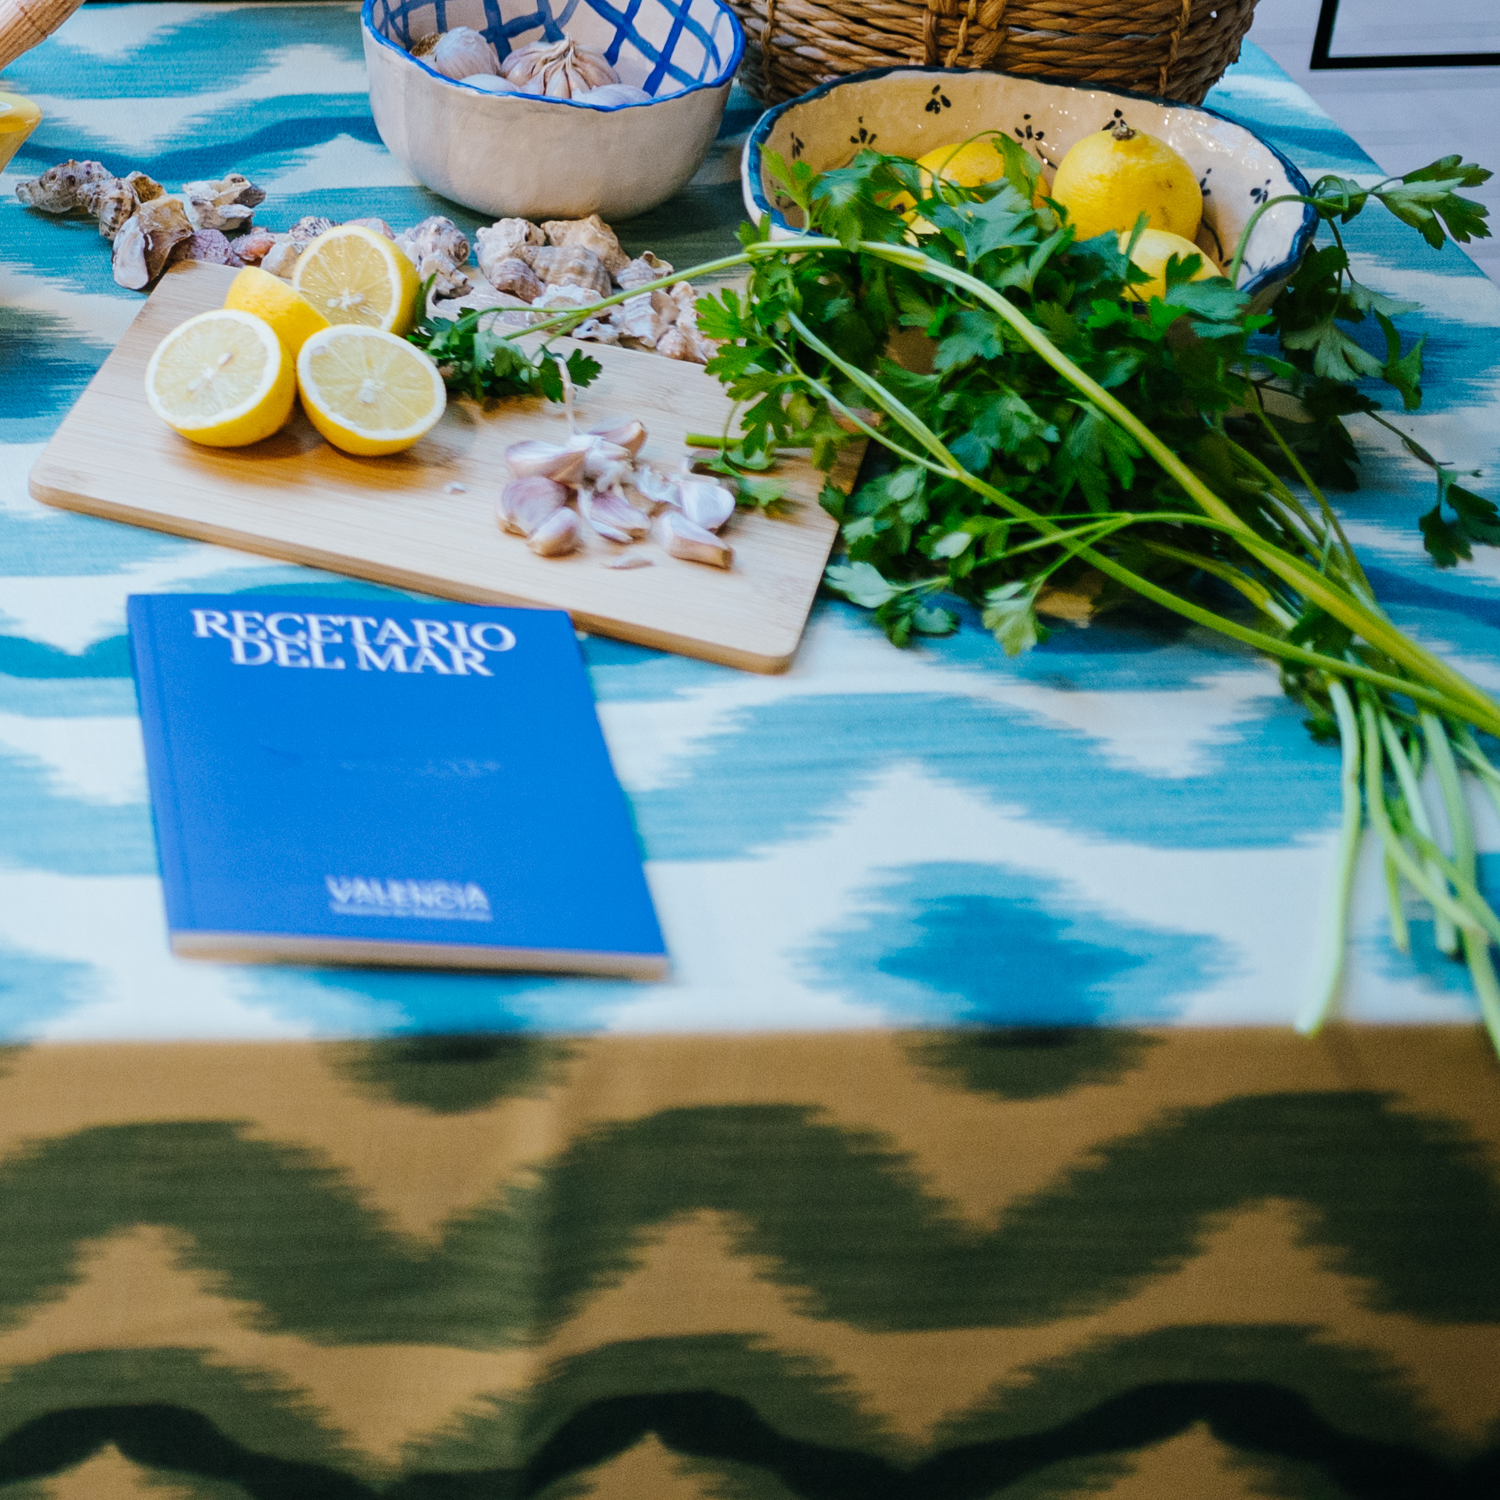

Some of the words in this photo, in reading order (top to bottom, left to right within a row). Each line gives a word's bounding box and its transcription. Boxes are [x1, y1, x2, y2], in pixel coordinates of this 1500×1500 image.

[190, 608, 517, 653] RECETARIO
[228, 638, 346, 671] DEL
[356, 644, 495, 677] MAR
[325, 875, 490, 911] VALENCIA
